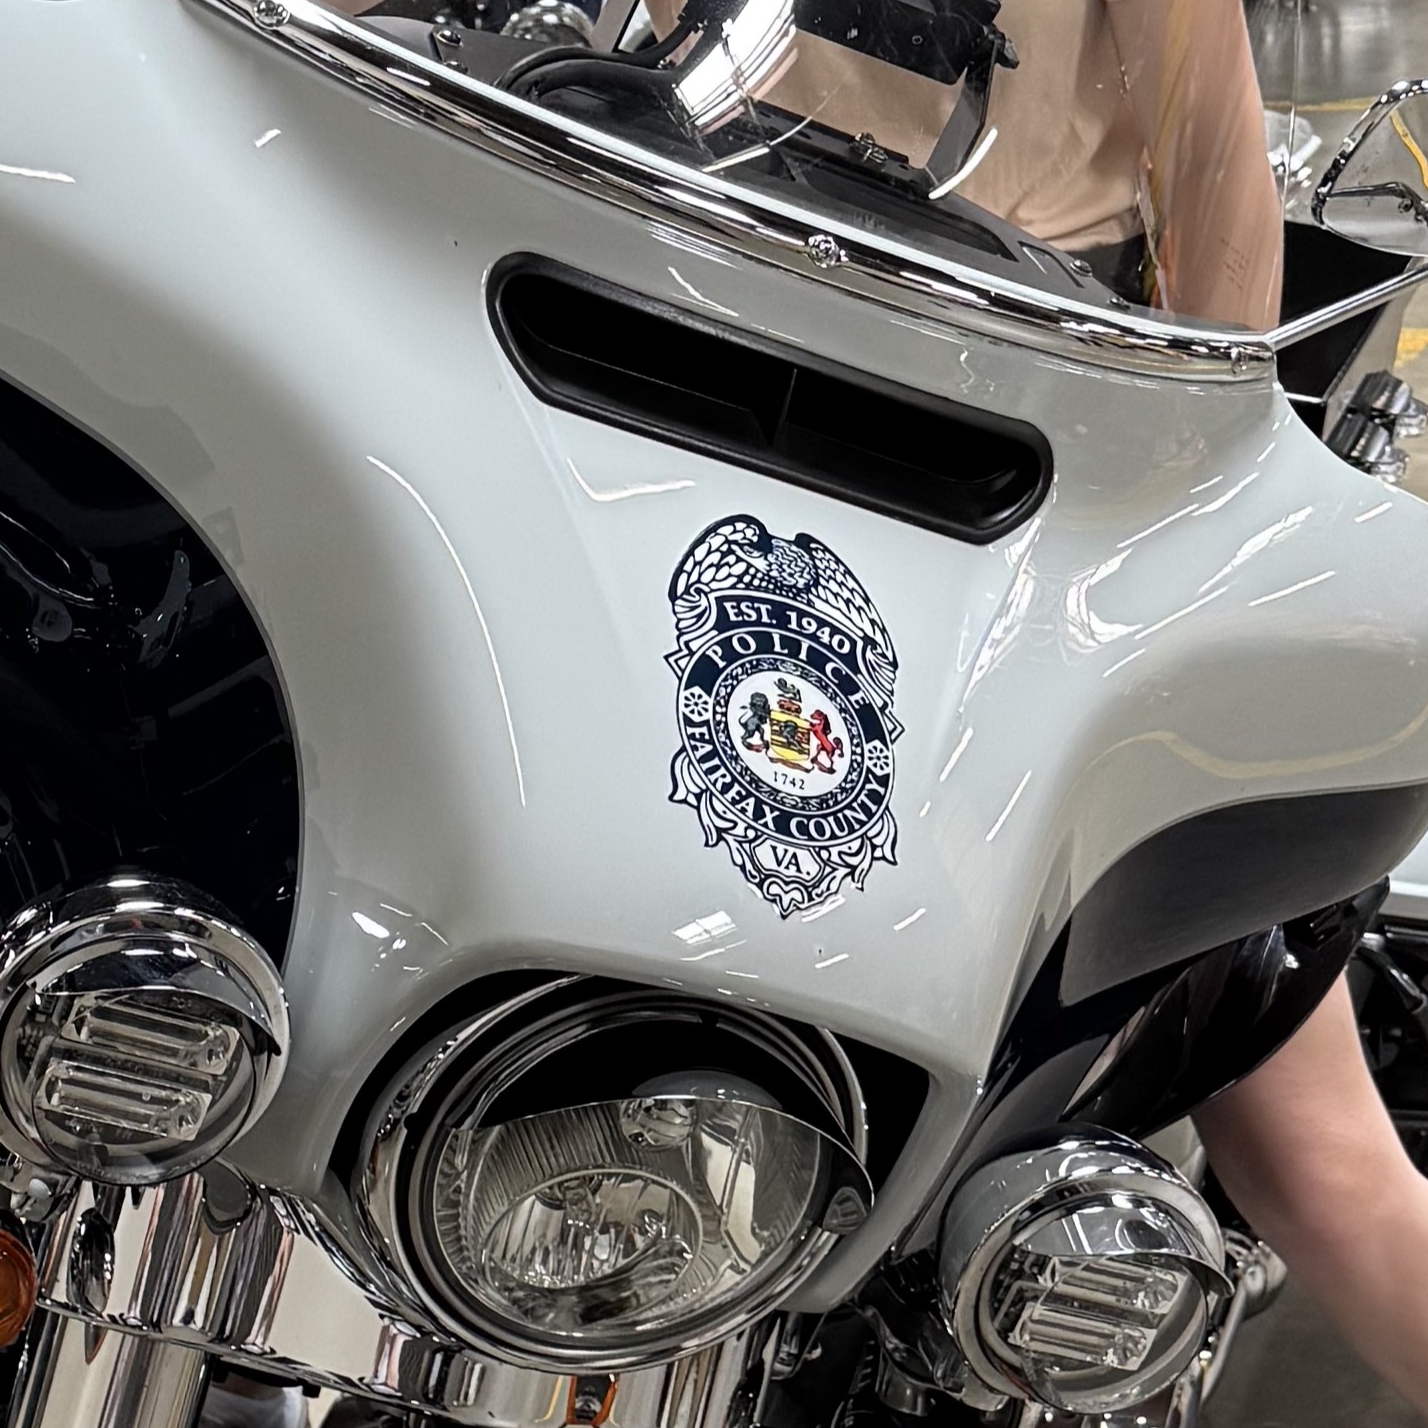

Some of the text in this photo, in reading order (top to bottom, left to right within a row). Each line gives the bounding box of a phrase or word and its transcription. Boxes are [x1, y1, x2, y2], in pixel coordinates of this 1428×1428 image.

[723, 601, 851, 654] EST. 1940
[705, 632, 870, 709] POLICE
[685, 725, 887, 840] FAIRFAX COUNTY
[774, 771, 805, 790] 1742
[769, 844, 812, 876] VA.
